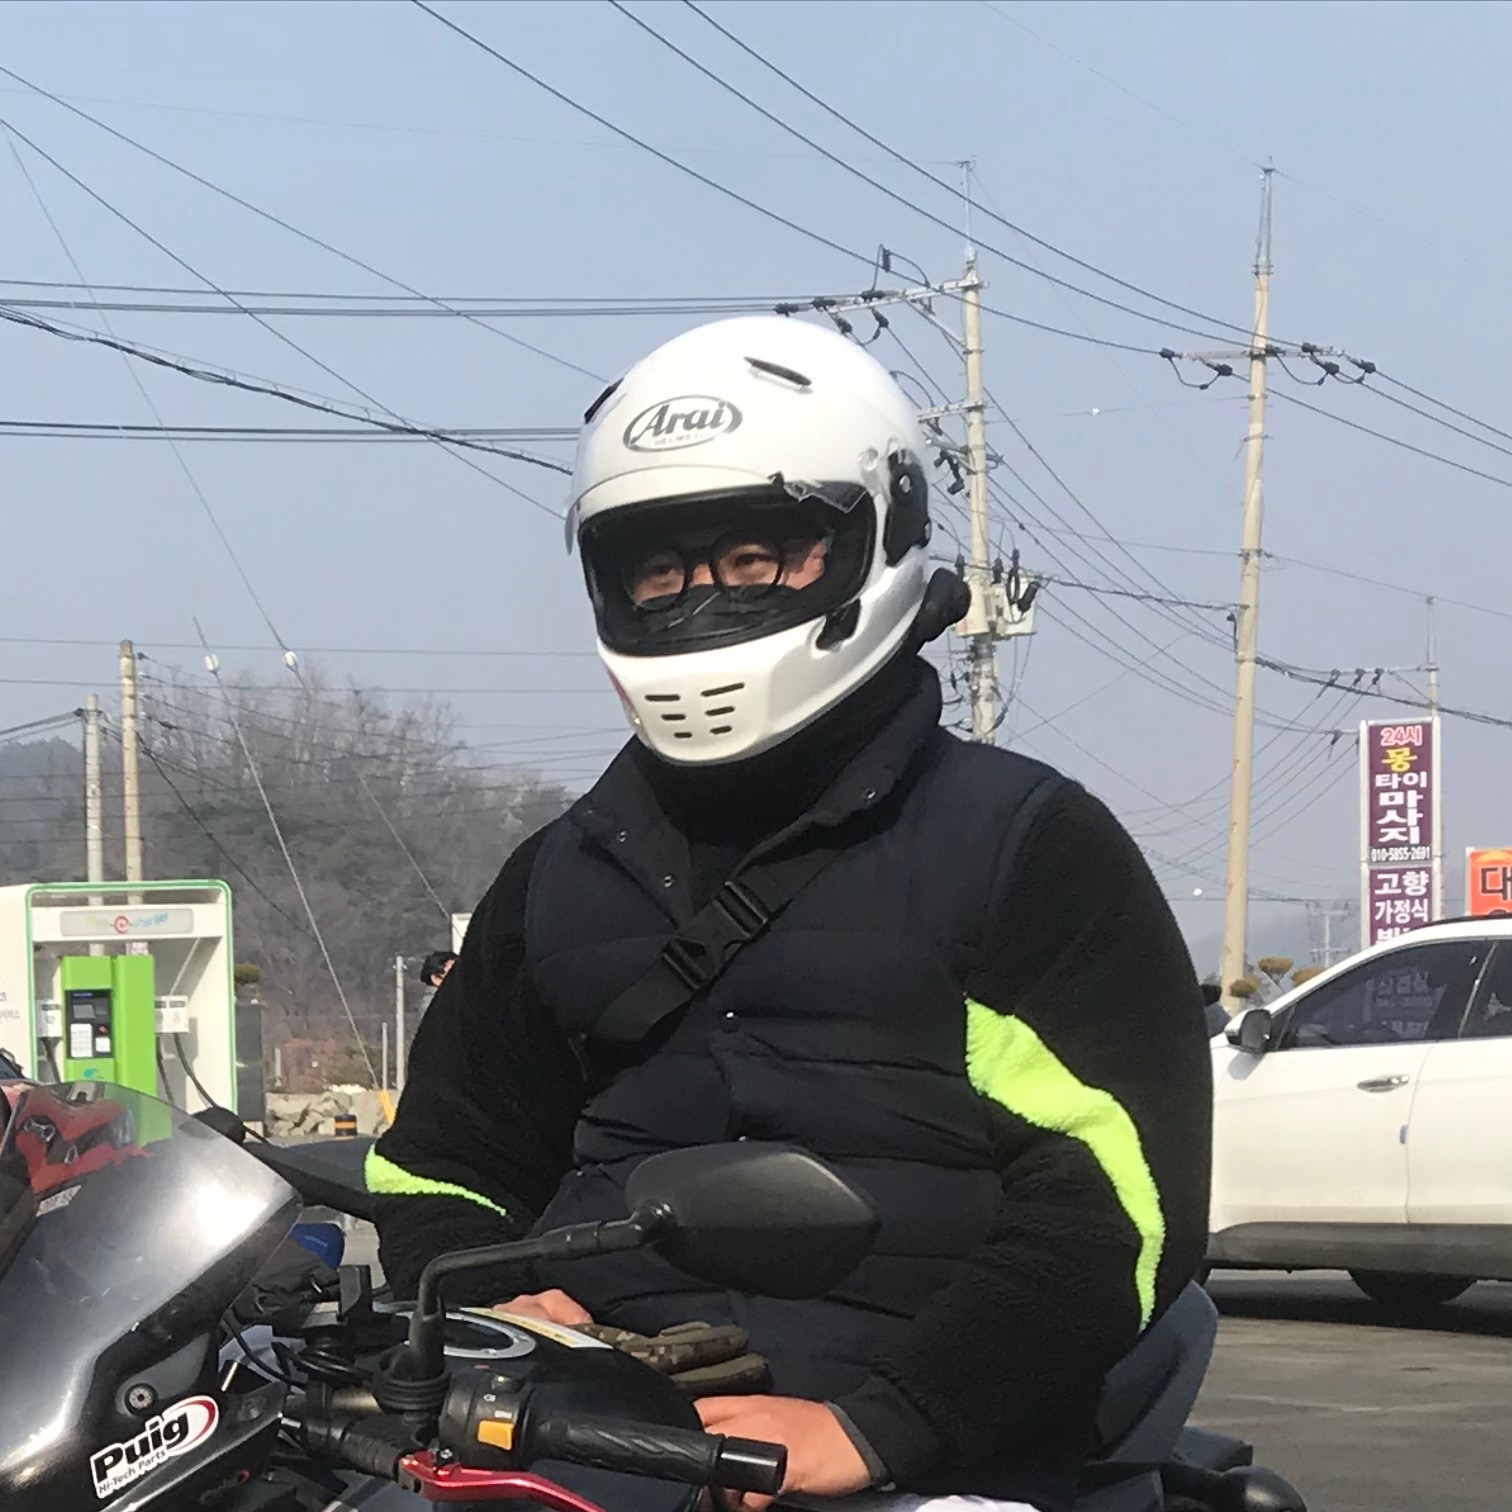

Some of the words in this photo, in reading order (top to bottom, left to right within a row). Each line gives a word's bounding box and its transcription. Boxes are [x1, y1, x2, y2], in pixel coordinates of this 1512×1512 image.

[630, 401, 727, 445] Arai
[1380, 725, 1423, 747] 24시
[1381, 747, 1419, 772] 몽
[1375, 771, 1428, 789] 타이
[1374, 871, 1430, 896] 고향
[1374, 898, 1429, 924] 가정식
[93, 1412, 190, 1484] Puig
[98, 1467, 136, 1495] Hi-Tech
[138, 1450, 166, 1470] Parts
